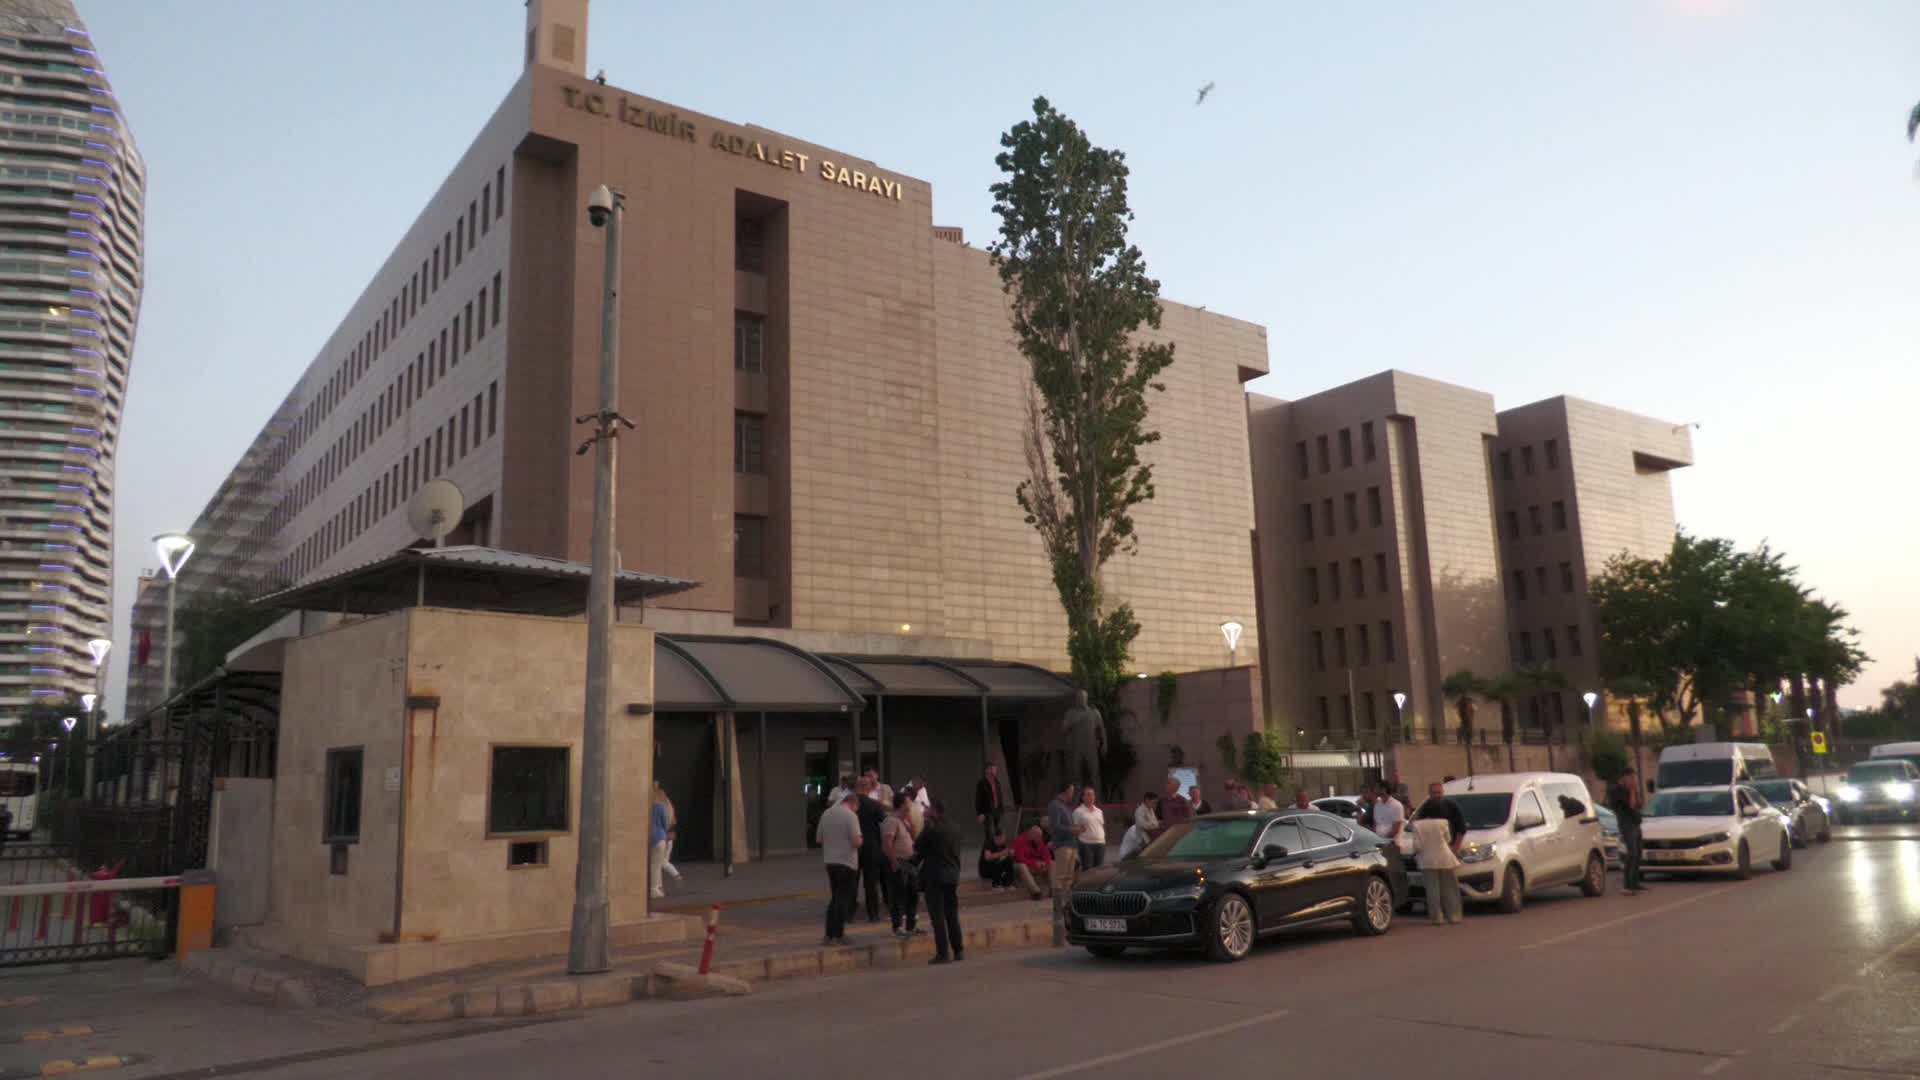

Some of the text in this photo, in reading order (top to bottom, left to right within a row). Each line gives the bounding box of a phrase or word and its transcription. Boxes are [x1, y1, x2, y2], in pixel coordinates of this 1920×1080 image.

[562, 85, 902, 200] T.C. İZMİR ADALET SARAYI
